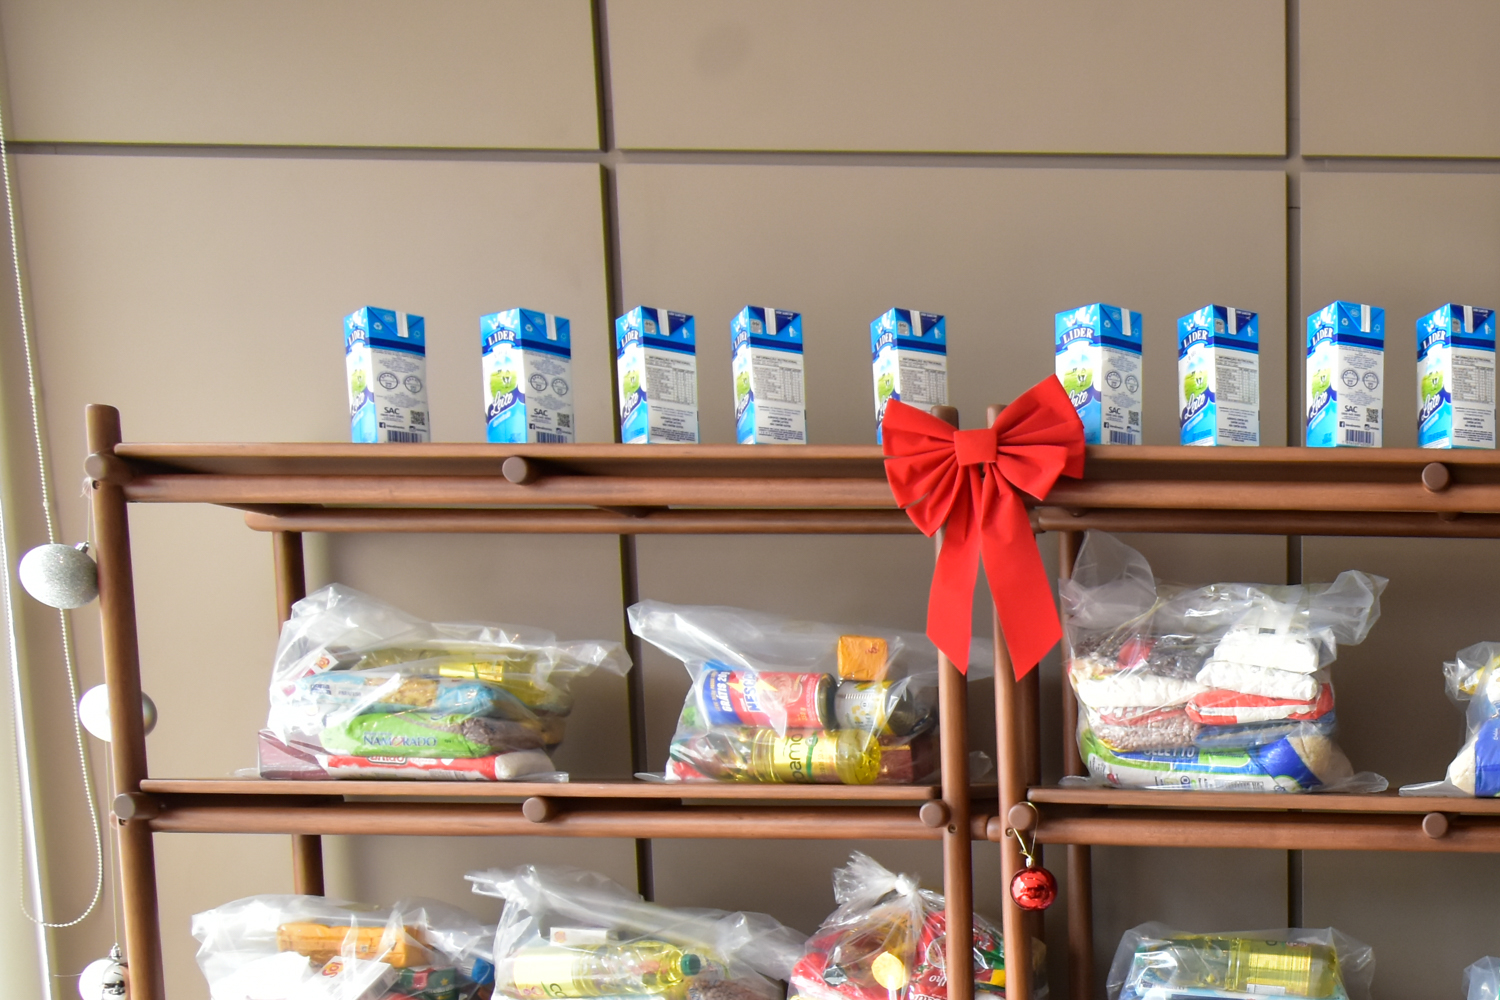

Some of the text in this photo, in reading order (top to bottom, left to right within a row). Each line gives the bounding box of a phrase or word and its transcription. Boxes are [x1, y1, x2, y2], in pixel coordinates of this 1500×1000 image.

[488, 330, 516, 346] LIDER
[621, 331, 639, 348] LIDER
[876, 332, 893, 351] LIDER
[1063, 327, 1094, 344] LIDER
[1183, 330, 1208, 348] LIDER
[1312, 327, 1334, 346] LIDER
[1423, 330, 1446, 350] LIDER
[384, 406, 400, 415] SAC
[534, 408, 548, 417] SAC
[1108, 406, 1121, 415] SAC
[1344, 405, 1358, 414] SAC
[716, 682, 733, 712] GRÁTIS
[363, 735, 438, 747] NAMORADO
